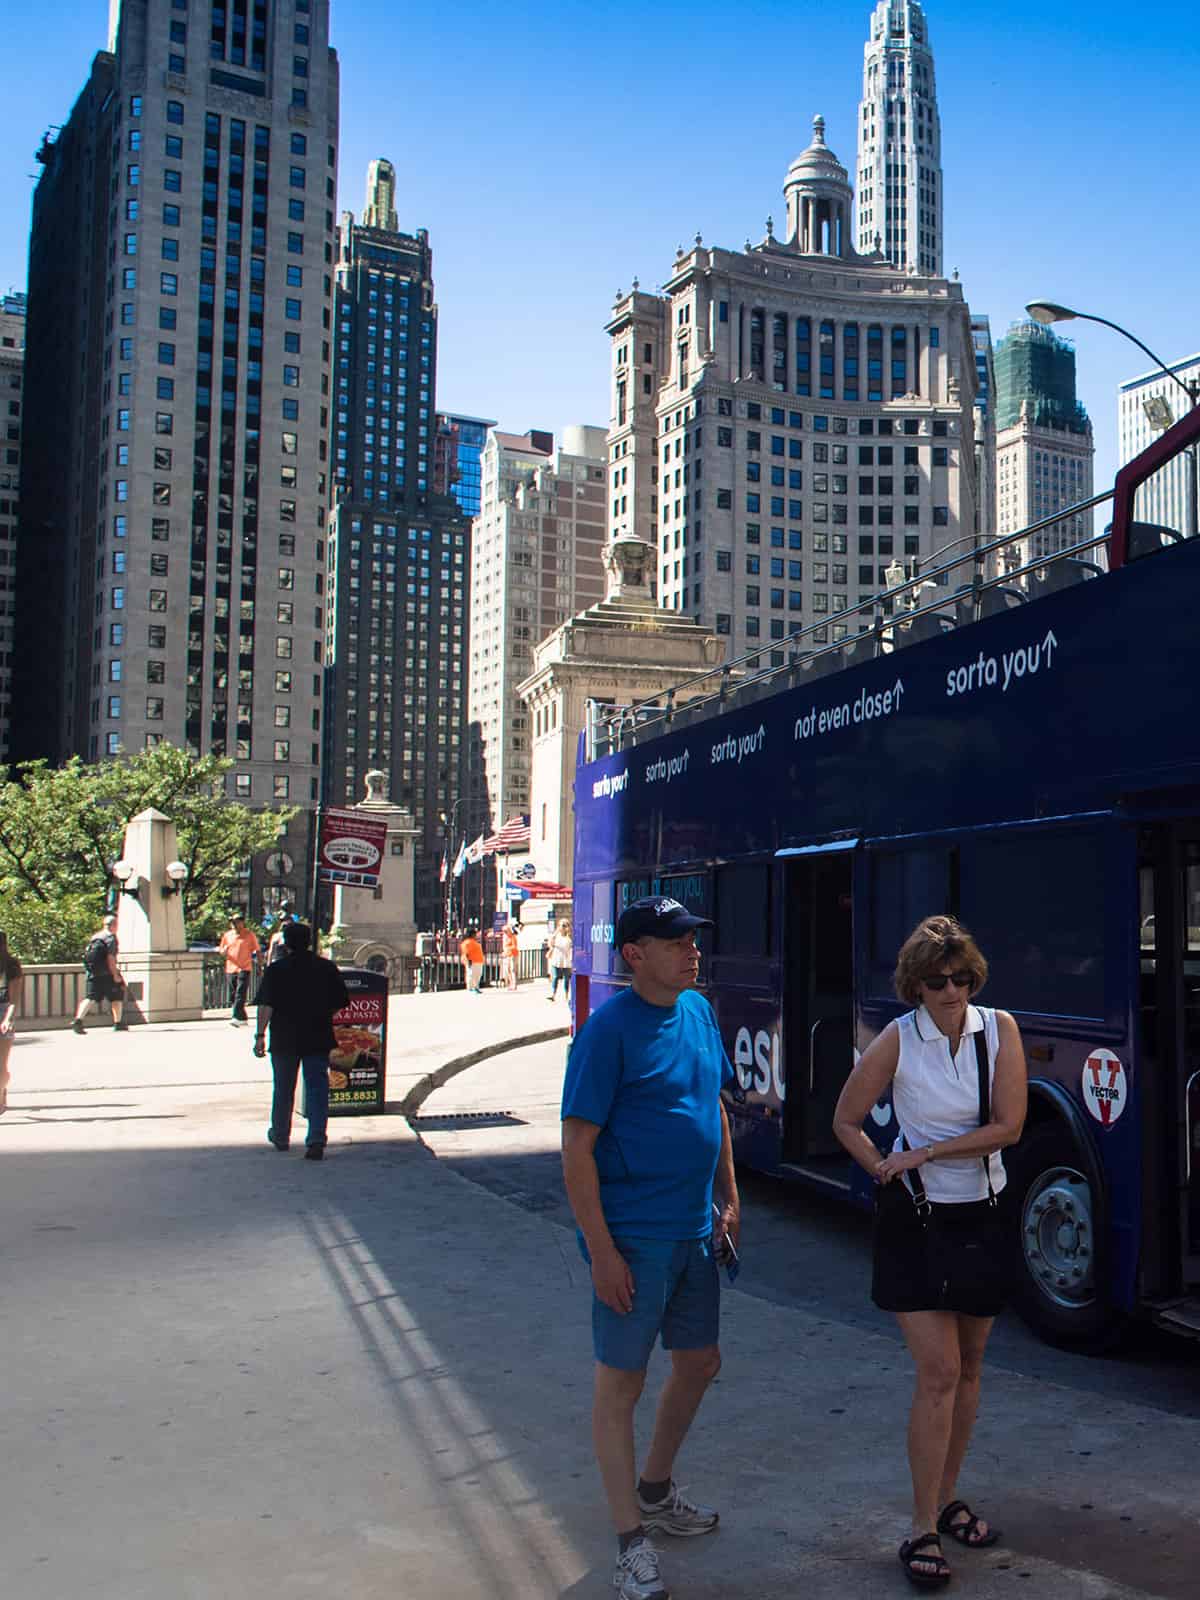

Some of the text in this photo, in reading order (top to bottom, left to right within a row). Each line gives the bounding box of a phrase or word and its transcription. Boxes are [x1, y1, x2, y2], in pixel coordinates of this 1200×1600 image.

[946, 645, 1040, 696] sorta you
[794, 687, 892, 740] not even close
[711, 734, 757, 765] sorta you
[646, 755, 683, 783] sorta you
[593, 774, 624, 799] sorta you
[346, 999, 380, 1011] NO'S
[1090, 1085, 1119, 1100] VECTOR
